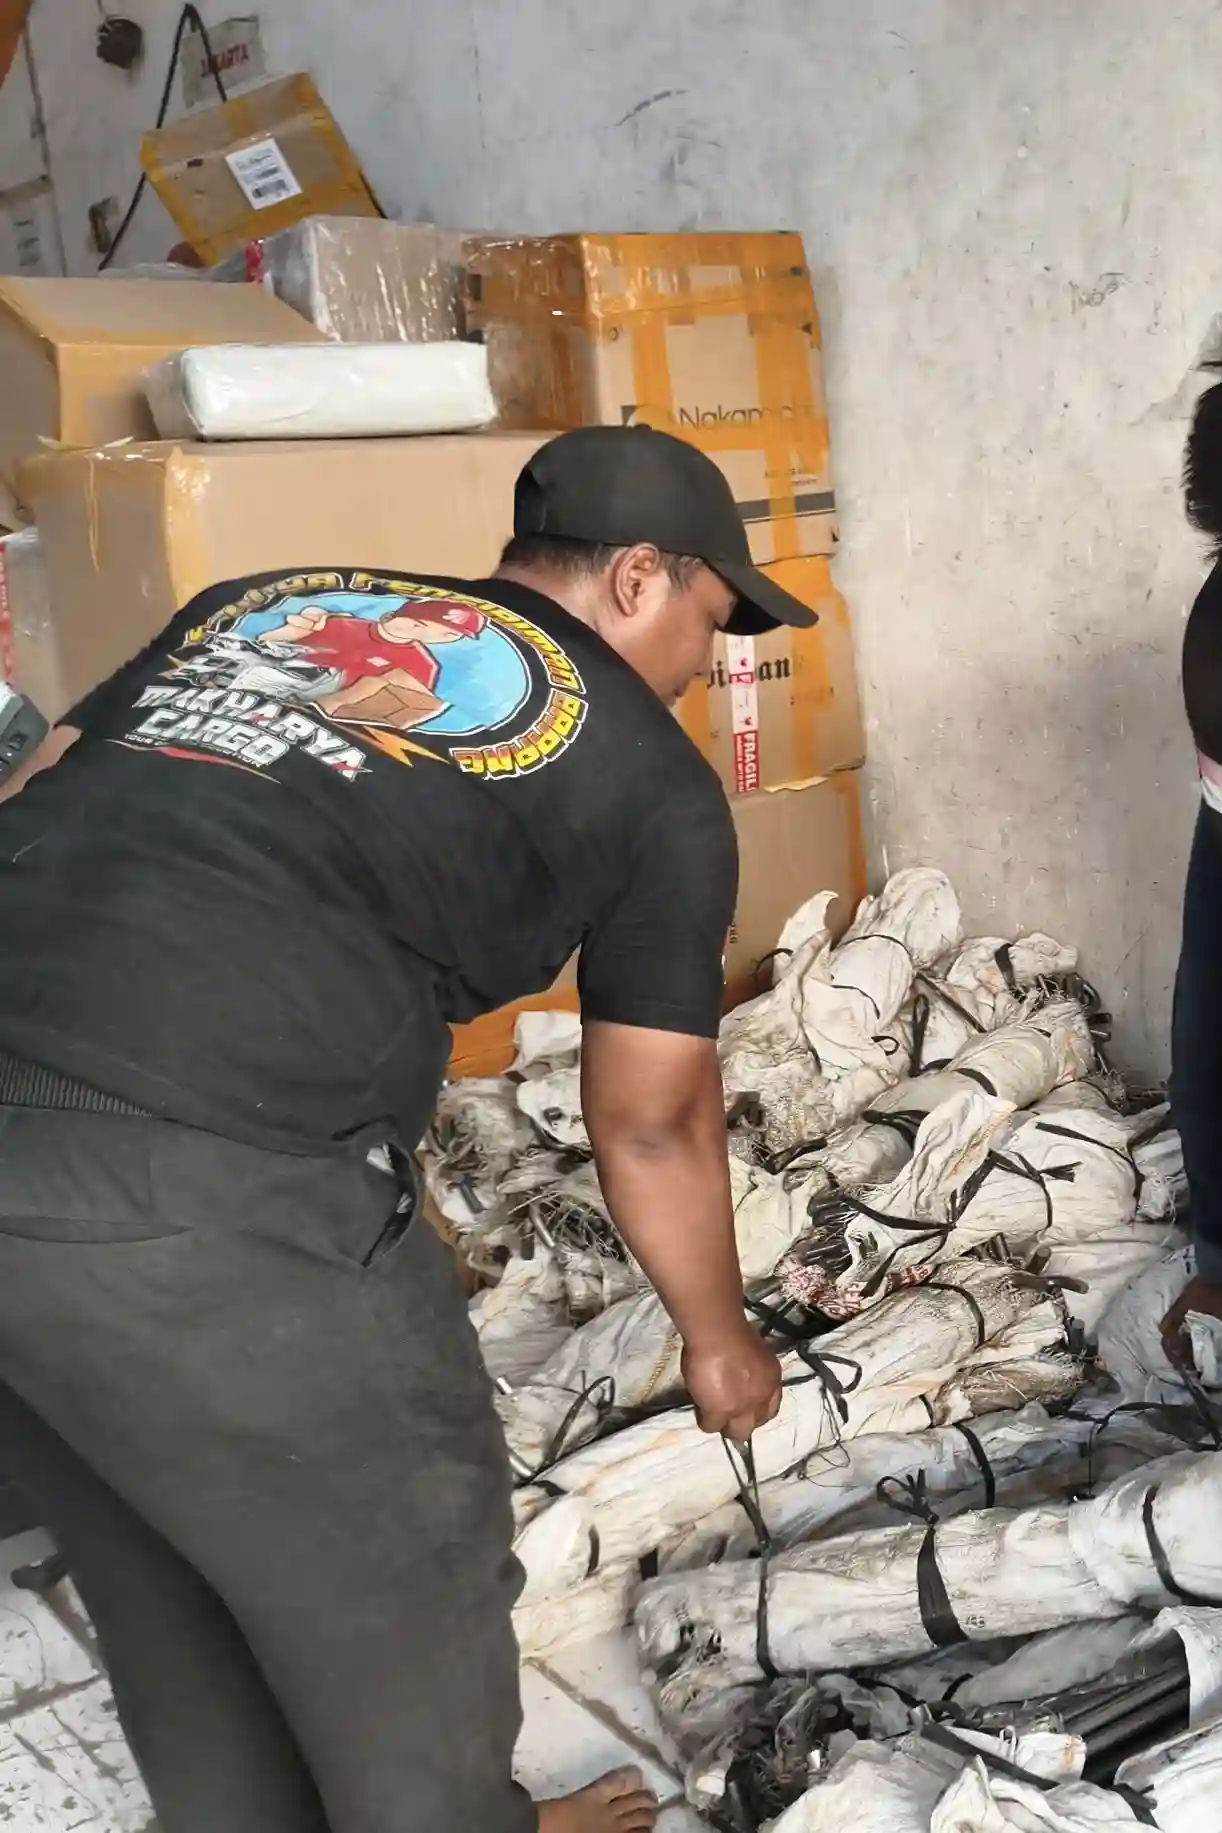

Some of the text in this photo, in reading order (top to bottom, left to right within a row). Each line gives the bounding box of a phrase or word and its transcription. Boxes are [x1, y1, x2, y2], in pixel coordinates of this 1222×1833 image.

[131, 685, 373, 782] MAKHARYA
[134, 708, 291, 766] CARGO
[743, 732, 758, 791] FRAGIL
